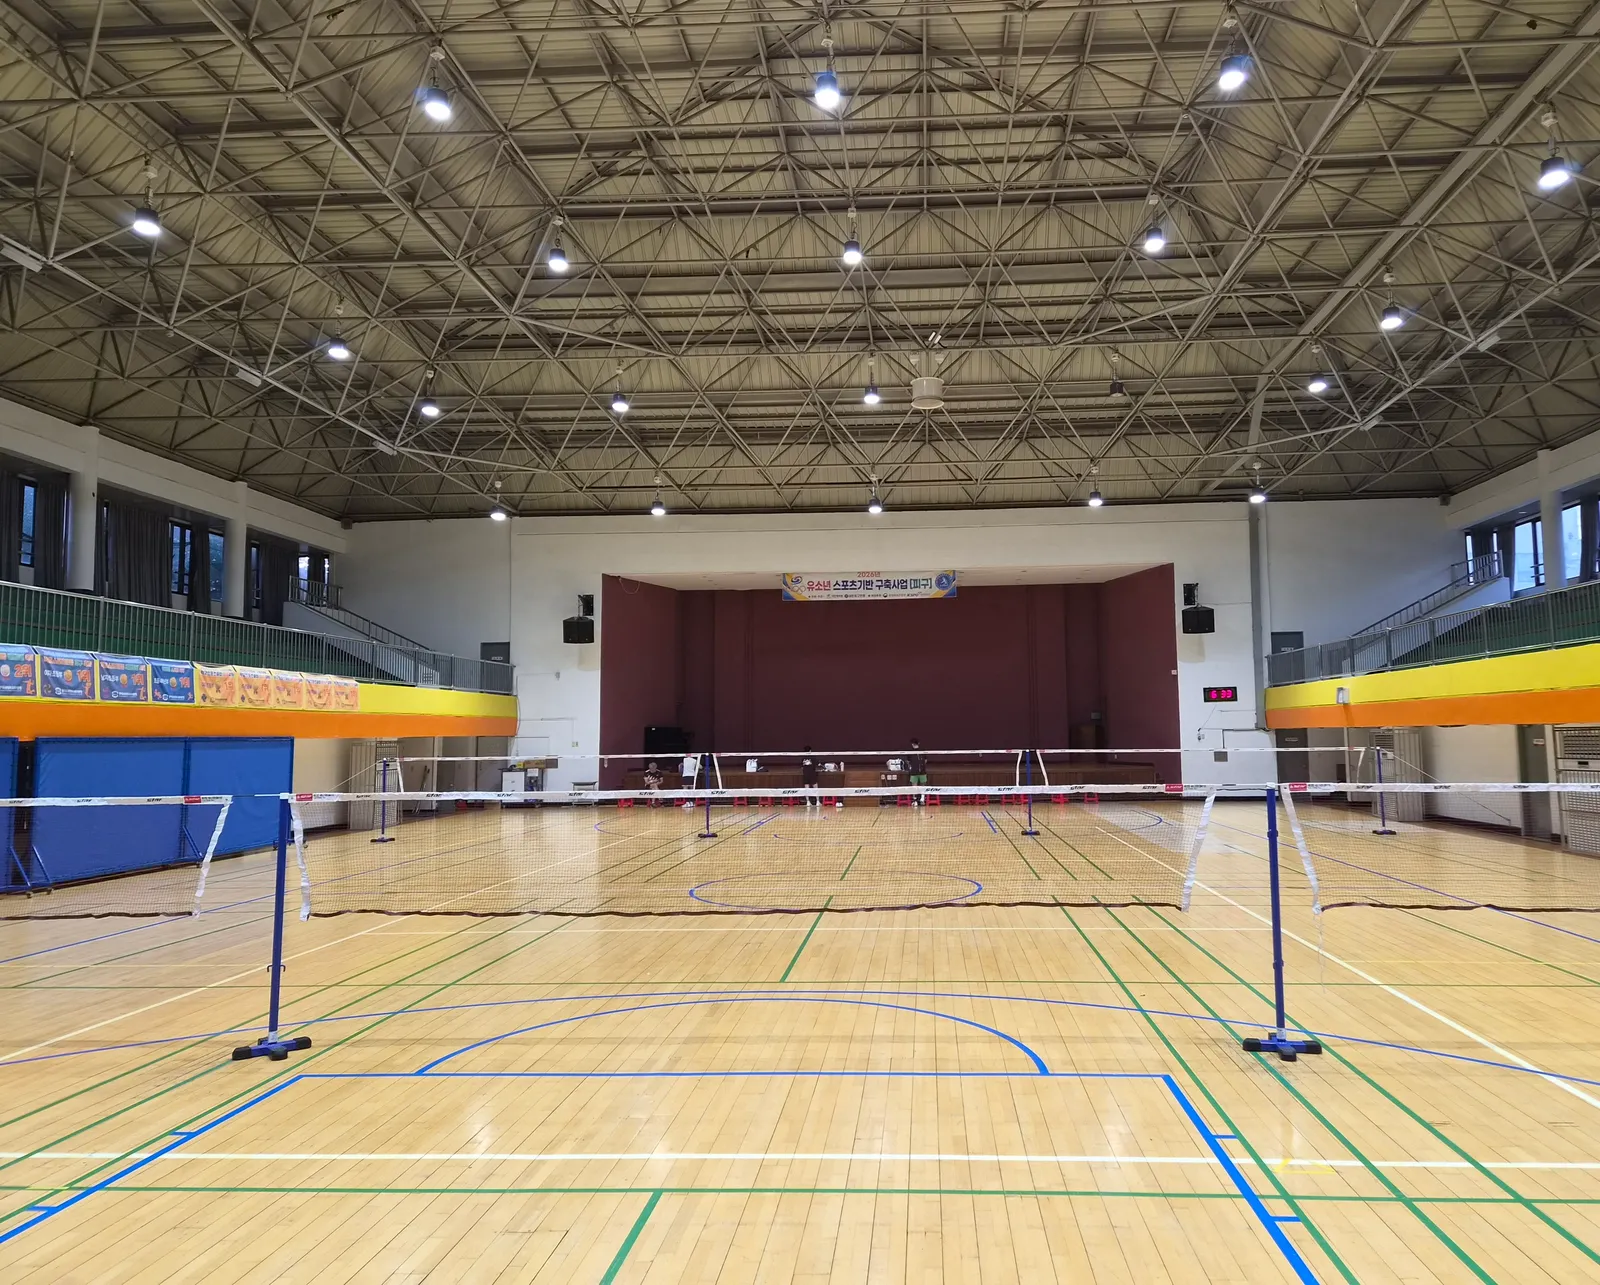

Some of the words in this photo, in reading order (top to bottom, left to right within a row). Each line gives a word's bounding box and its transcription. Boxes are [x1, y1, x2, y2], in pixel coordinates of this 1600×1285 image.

[807, 580, 831, 591] 유소년
[833, 579, 874, 591] 스포츠기반
[875, 578, 908, 590] 구축사업
[909, 577, 933, 590] [피구]
